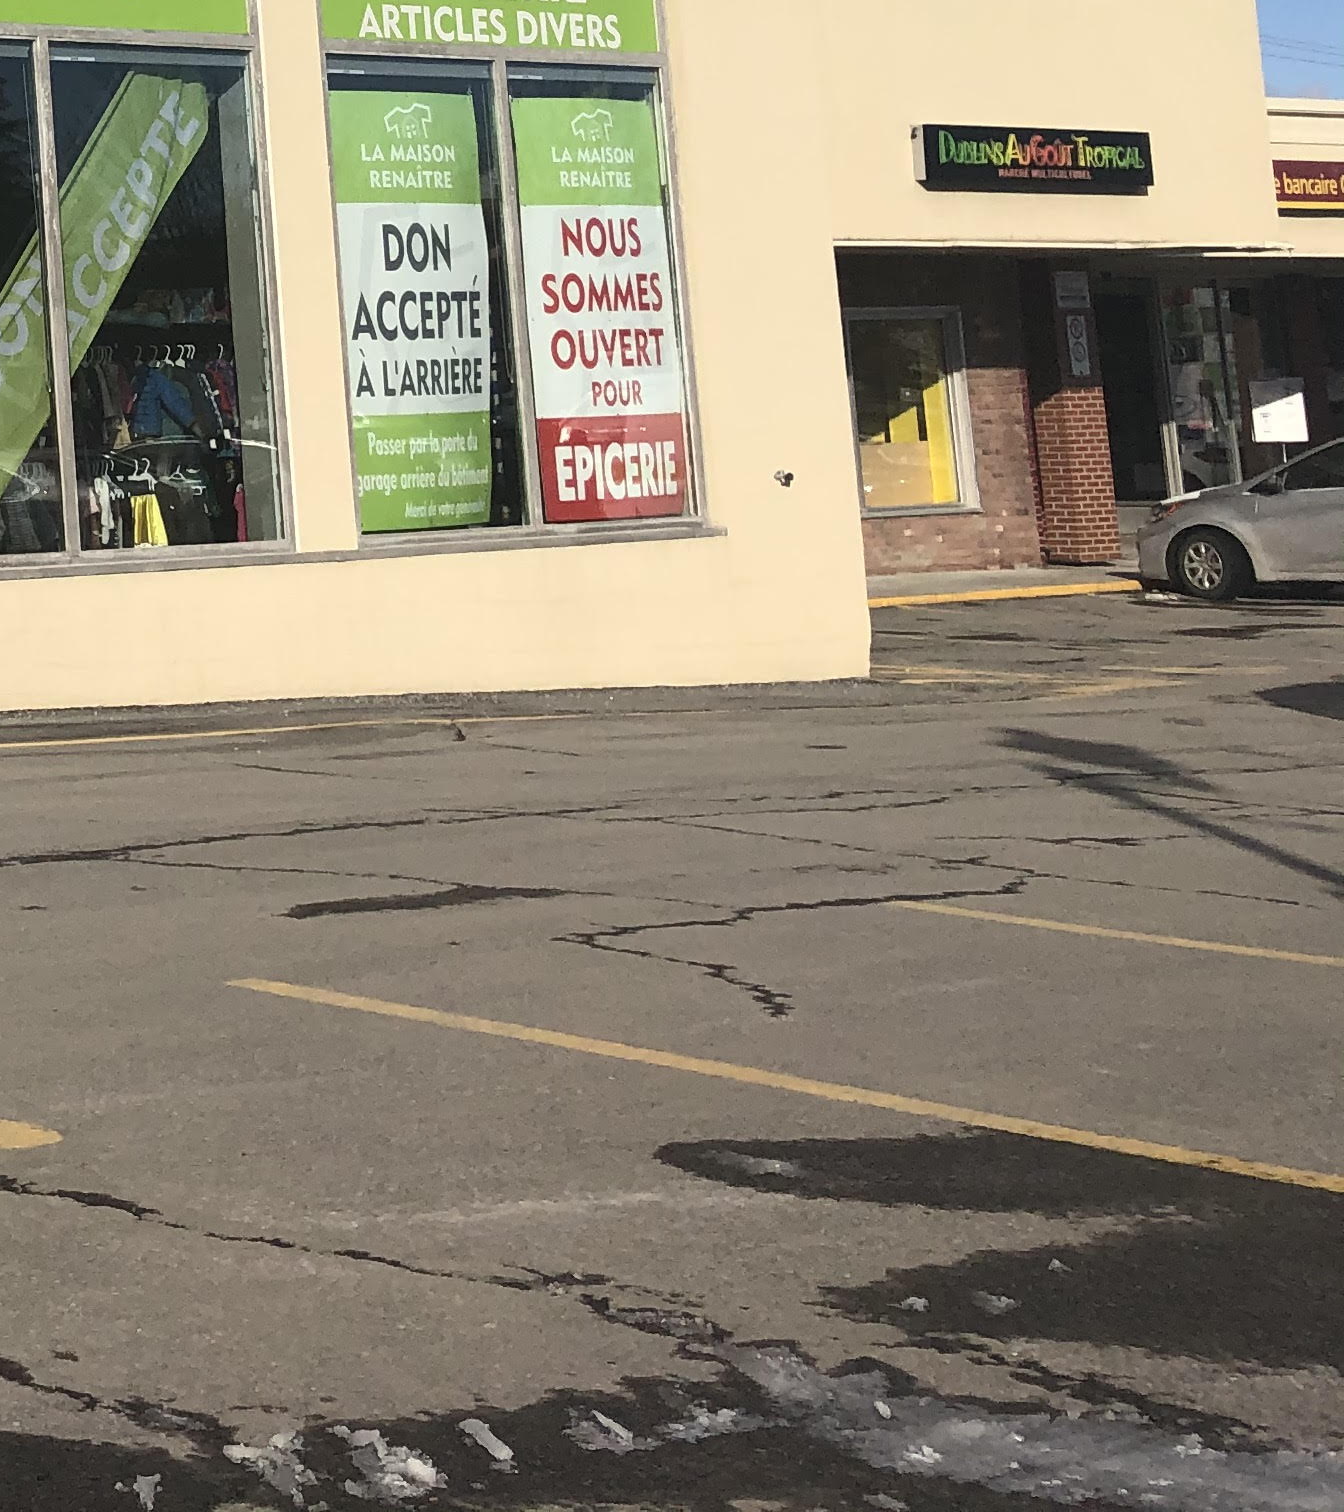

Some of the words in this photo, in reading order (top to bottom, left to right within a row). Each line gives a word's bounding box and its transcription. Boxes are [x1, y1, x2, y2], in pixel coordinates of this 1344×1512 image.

[358, 3, 507, 45] ARTICLES
[516, 10, 622, 49] DIVERS
[360, 144, 385, 161] LA
[390, 144, 456, 163] MAISON
[551, 147, 574, 163] LA
[577, 147, 634, 164] MAISON
[369, 165, 453, 189] RENAÎTRE
[1282, 171, 1338, 195] bancaire
[382, 222, 452, 272] DON
[560, 217, 641, 257] NOUS
[352, 276, 482, 341] ACCEPTÉ
[541, 272, 664, 314] SOMMES
[550, 327, 665, 370] OUVERT
[356, 350, 376, 398] À
[382, 346, 483, 397] L'ARRIÈRE
[591, 380, 644, 407] POUR
[367, 432, 406, 456] Passer
[554, 427, 678, 502] ÉPICERIE
